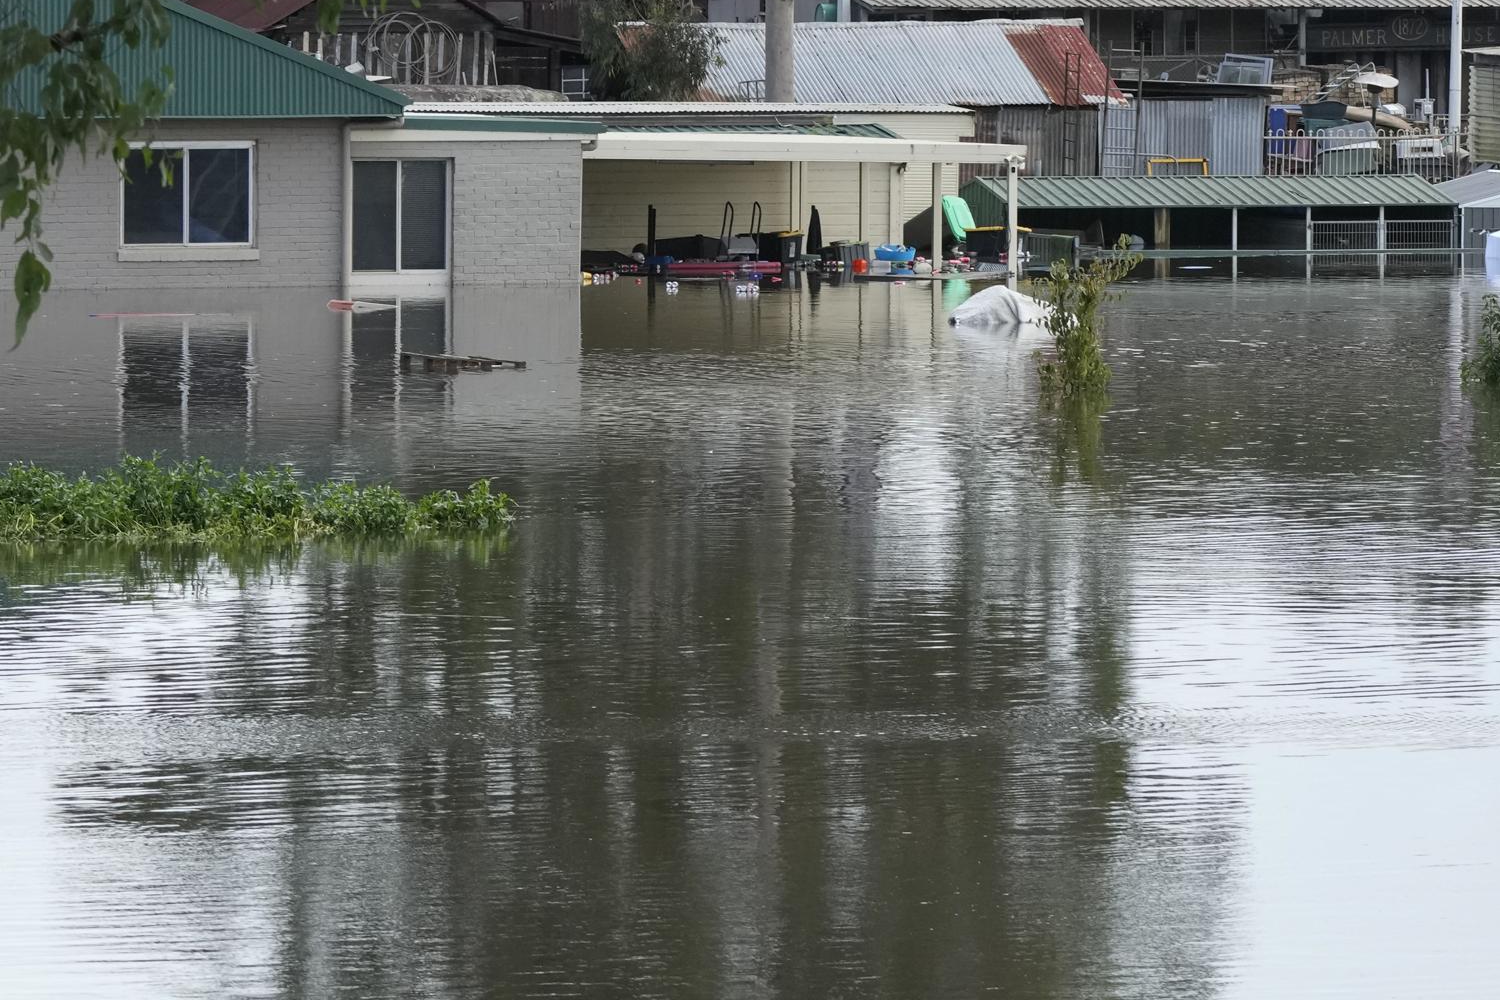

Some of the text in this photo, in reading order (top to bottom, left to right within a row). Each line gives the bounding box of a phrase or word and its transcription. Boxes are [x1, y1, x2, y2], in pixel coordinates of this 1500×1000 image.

[1321, 17, 1497, 47] PALMER 1872 HUSE
